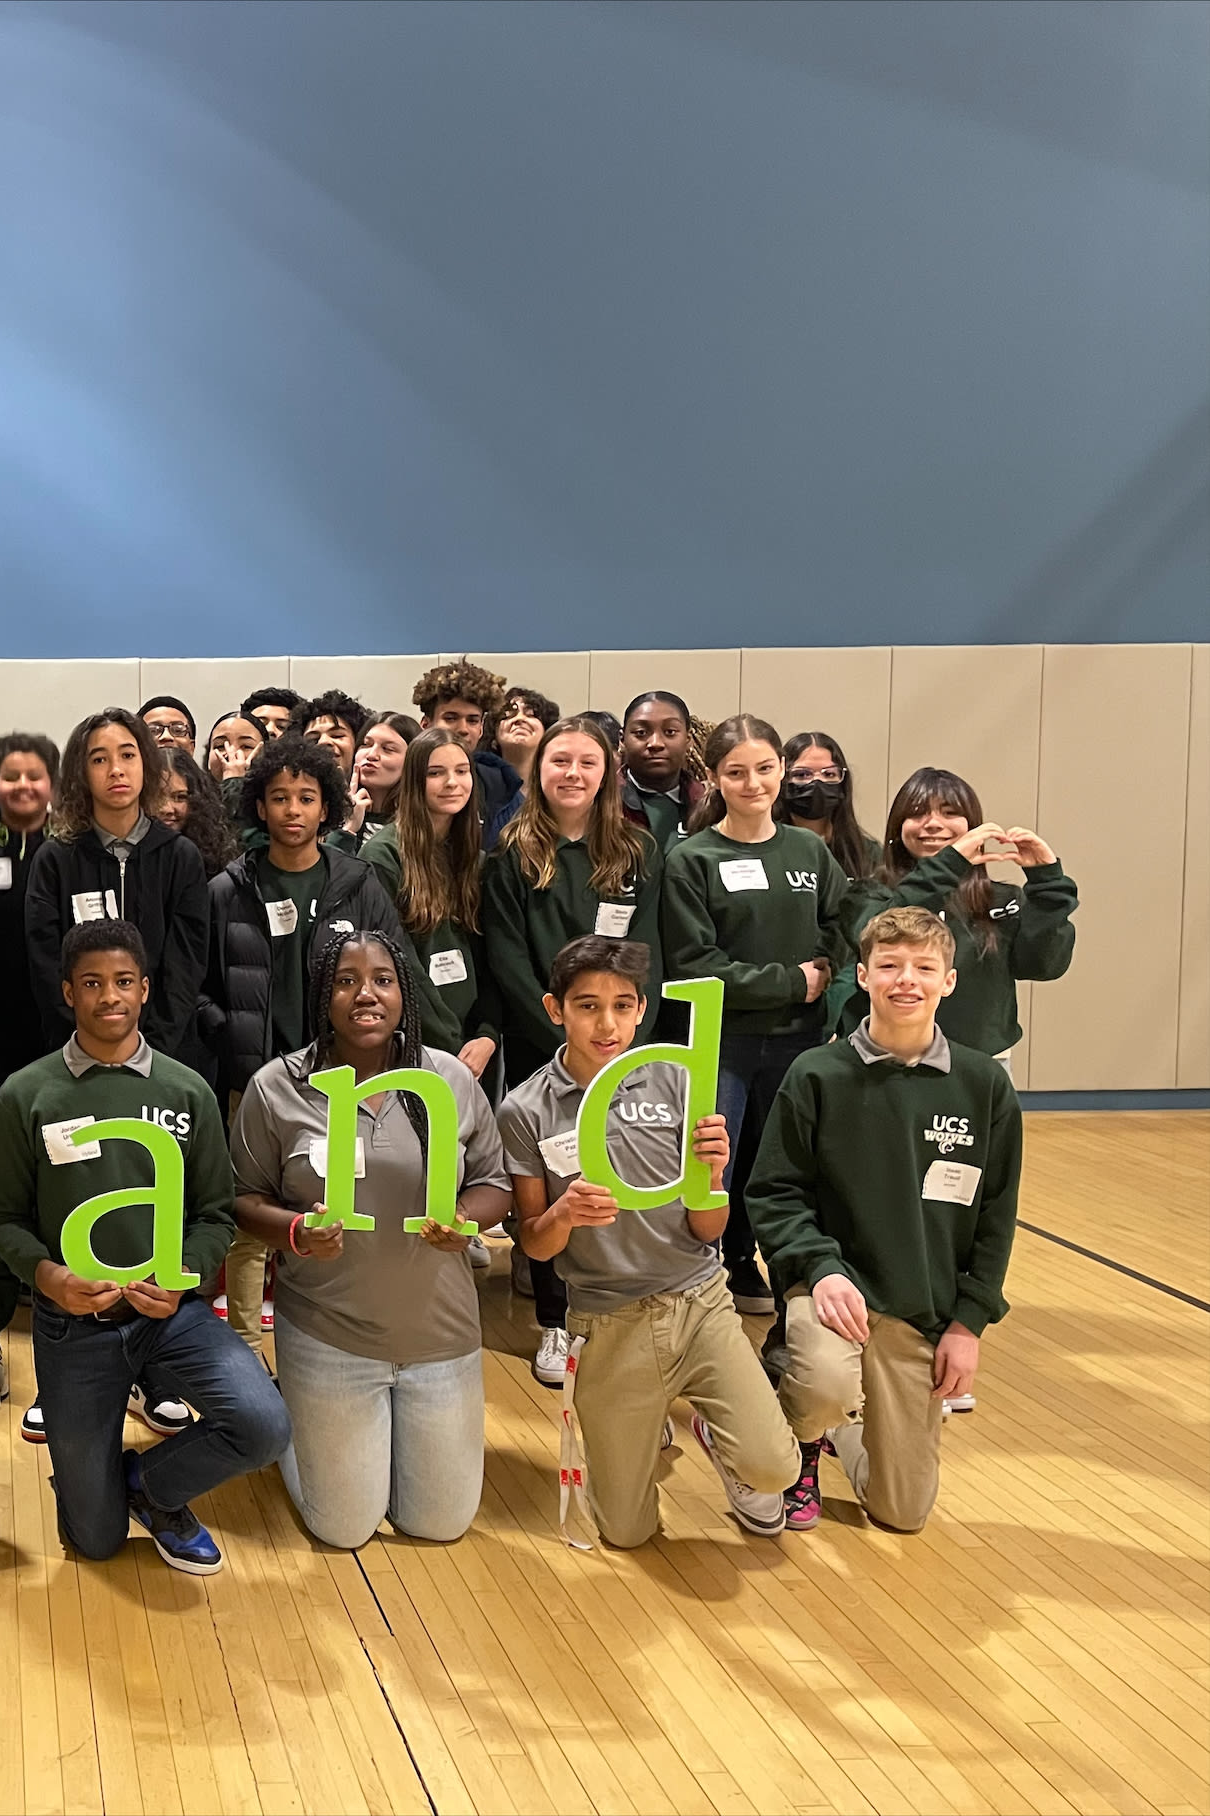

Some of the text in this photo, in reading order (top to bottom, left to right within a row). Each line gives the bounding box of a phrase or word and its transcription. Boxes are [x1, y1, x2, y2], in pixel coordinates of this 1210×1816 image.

[785, 871, 818, 890] UCS
[619, 1102, 672, 1122] UCS
[933, 1115, 970, 1134] UCS
[923, 1129, 975, 1147] WOLVES
